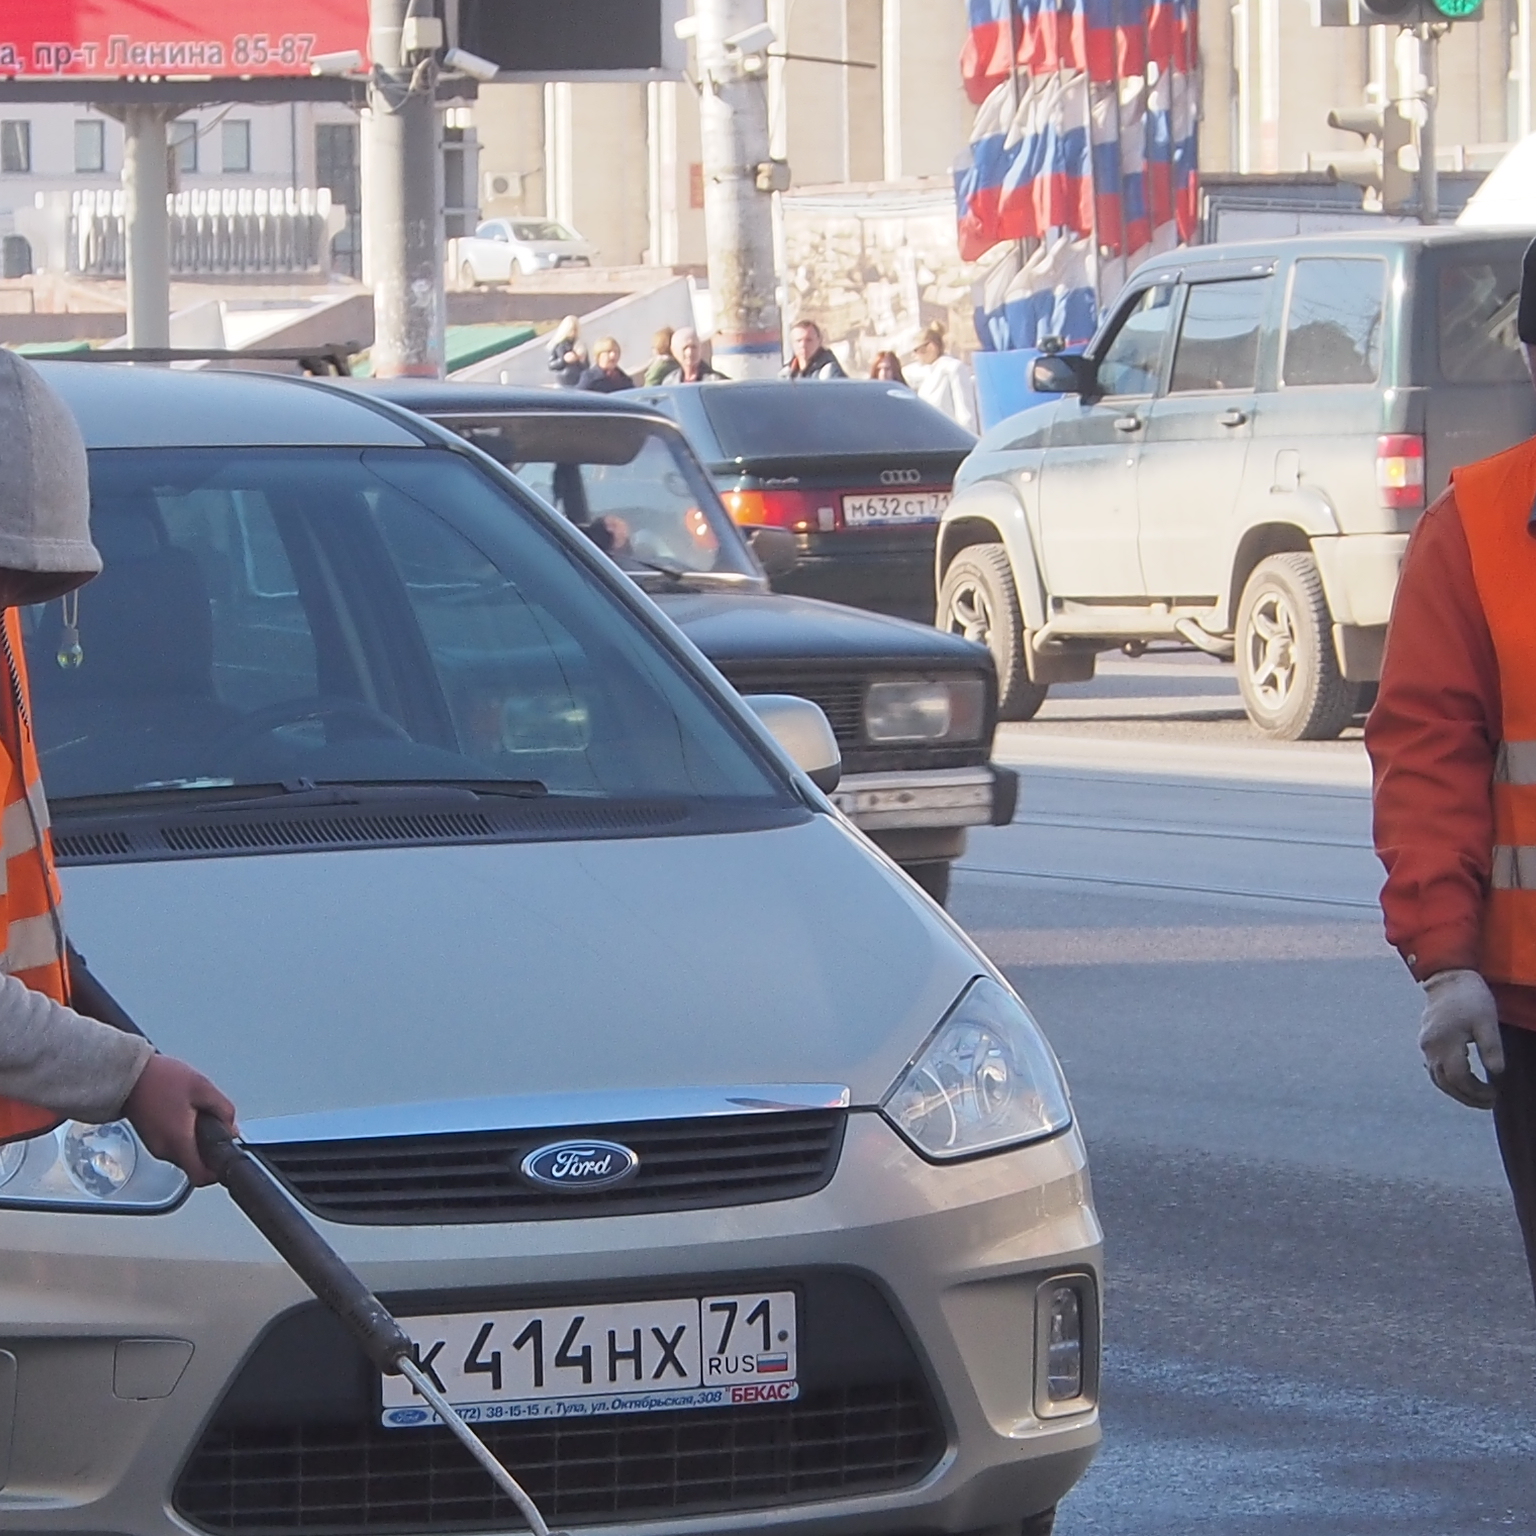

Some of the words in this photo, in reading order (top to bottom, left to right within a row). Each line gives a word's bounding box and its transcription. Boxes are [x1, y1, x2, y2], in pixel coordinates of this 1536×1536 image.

[105, 35, 226, 67] Ленина
[551, 1149, 612, 1178] Ford
[708, 1299, 772, 1356] 71
[707, 1353, 756, 1376] RUS
[485, 1403, 540, 1418] 38-15-15
